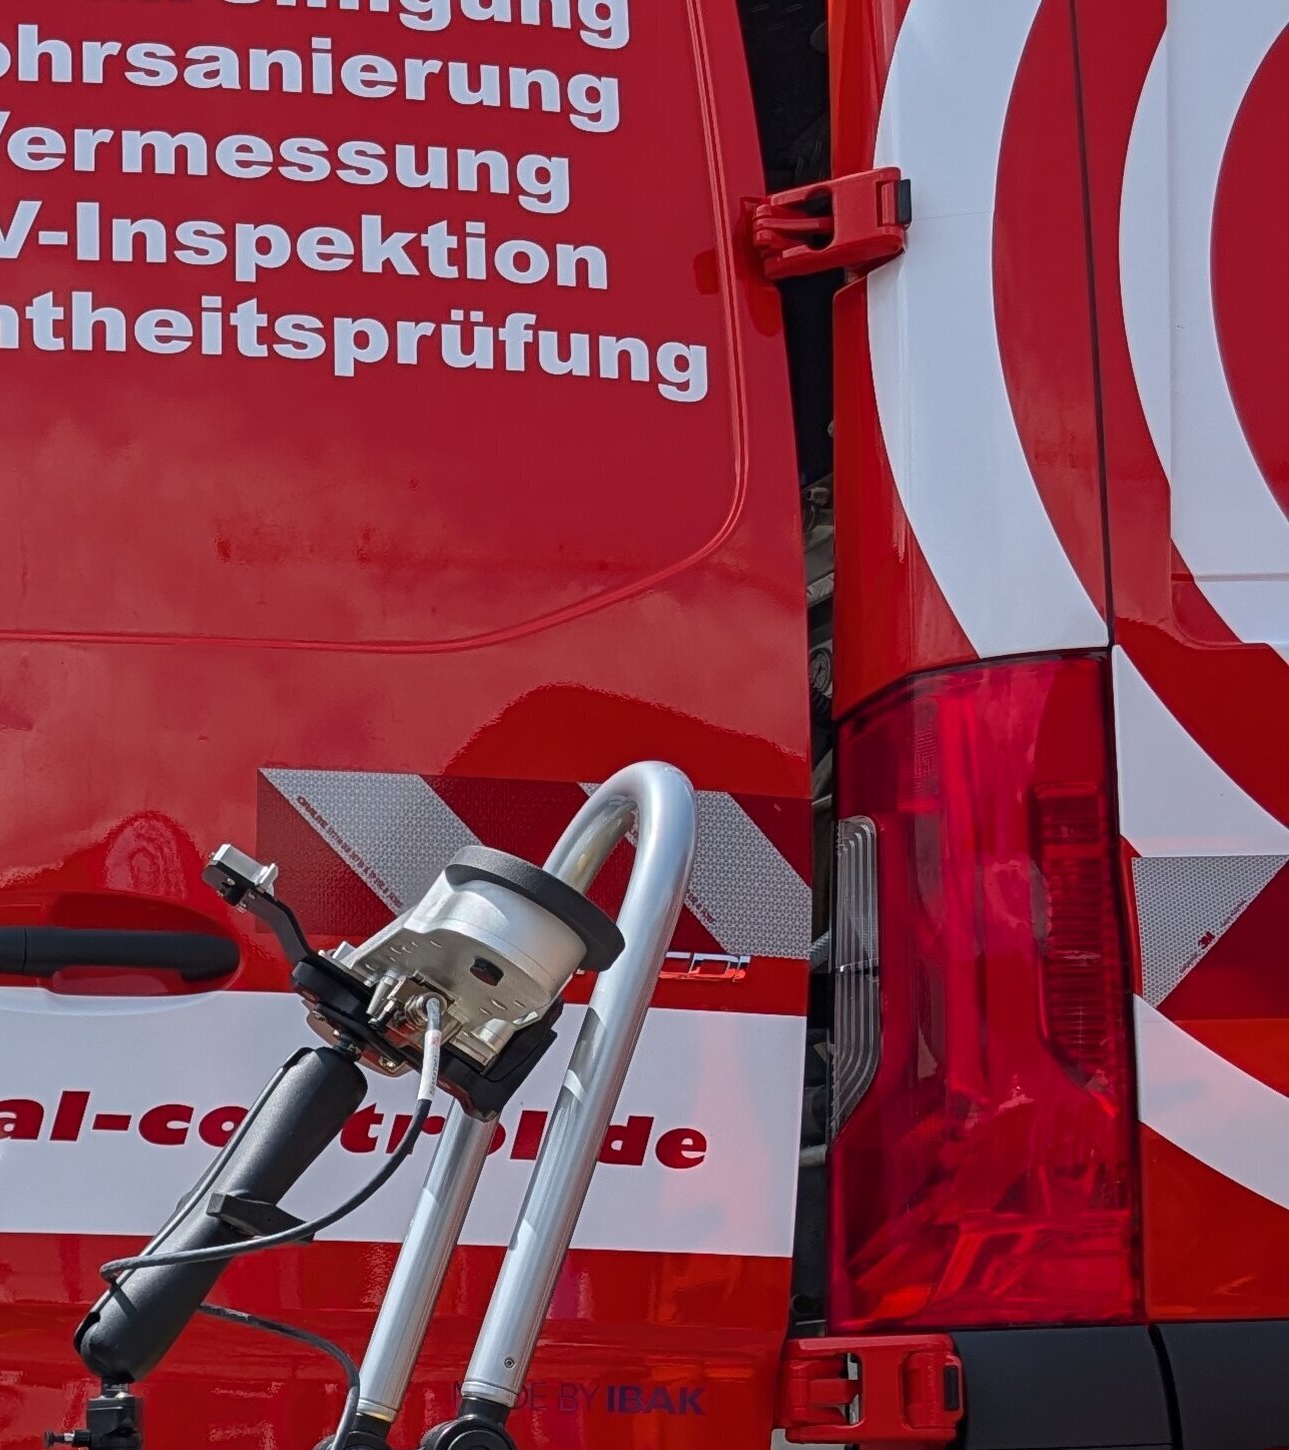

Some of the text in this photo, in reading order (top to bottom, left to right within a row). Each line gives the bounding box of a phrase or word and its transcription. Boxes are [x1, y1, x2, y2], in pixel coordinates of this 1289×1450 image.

[1198, 931, 1216, 949] 3M
[558, 1382, 600, 1414] BY
[606, 1384, 705, 1416] IBAK
